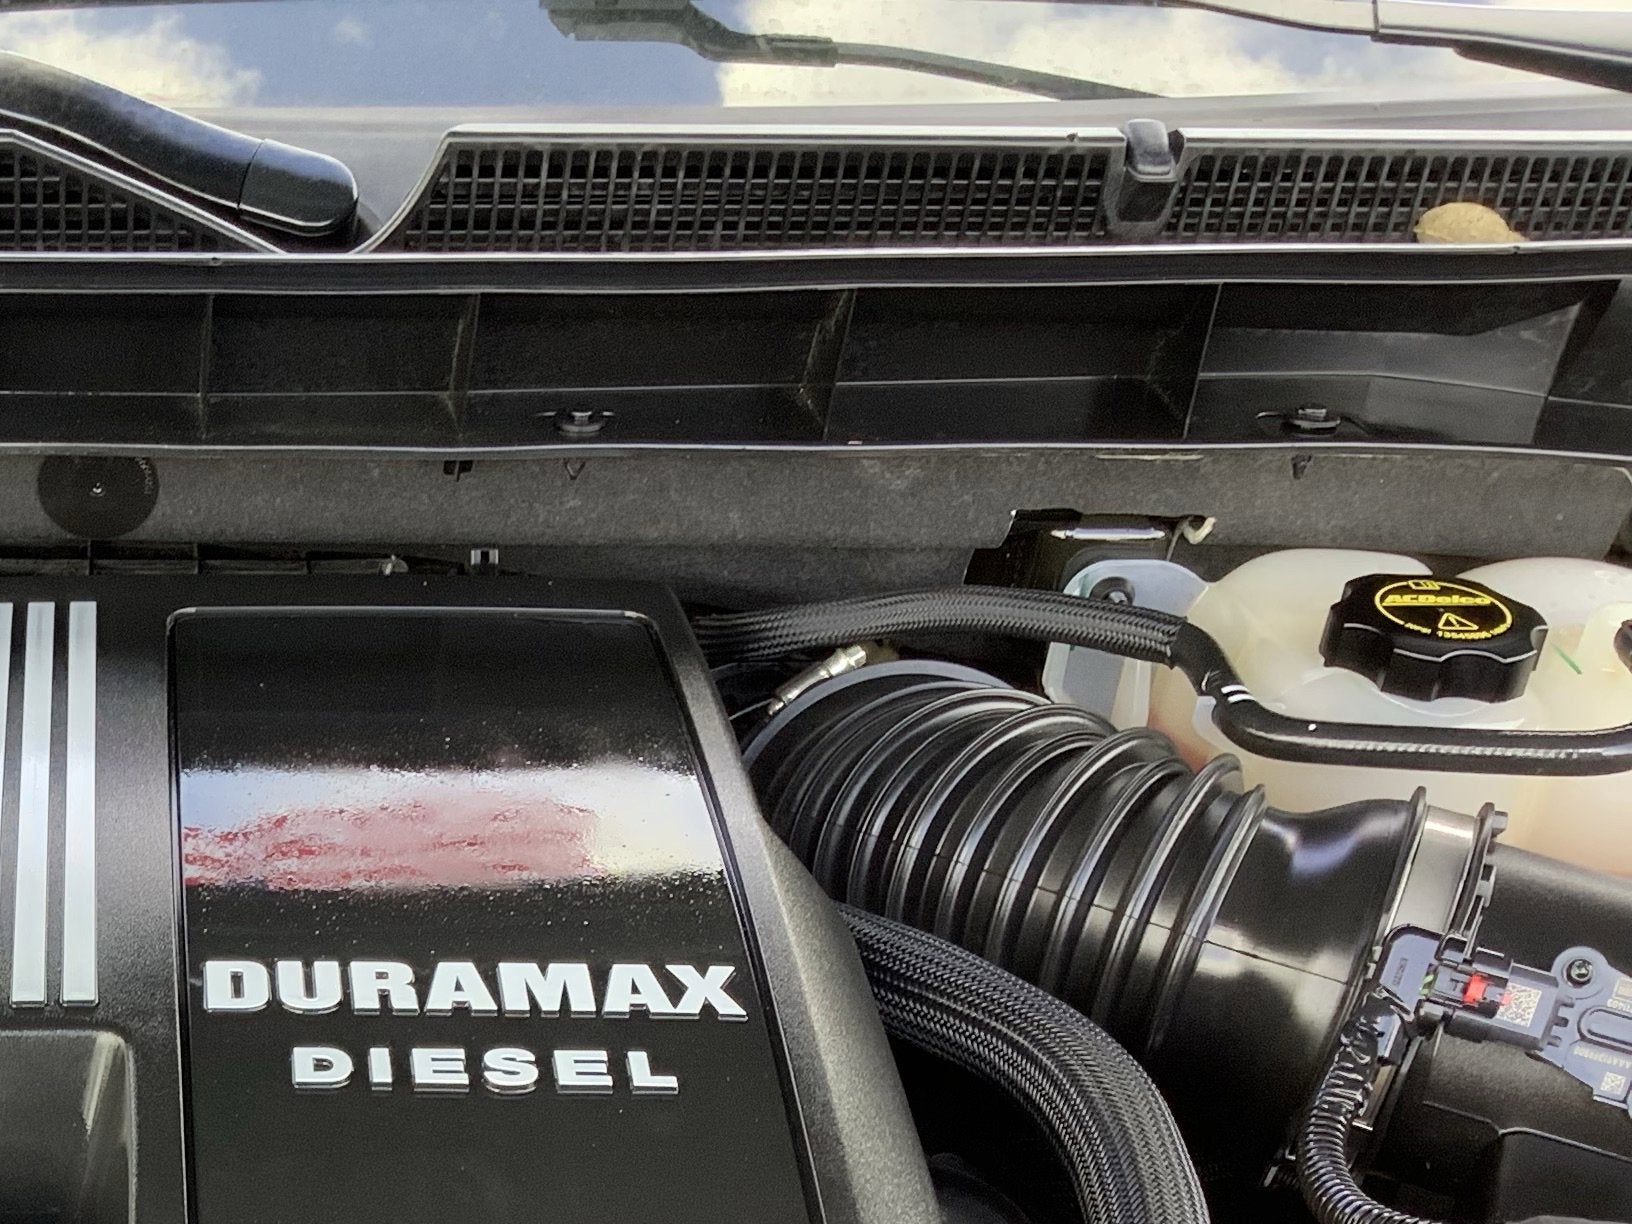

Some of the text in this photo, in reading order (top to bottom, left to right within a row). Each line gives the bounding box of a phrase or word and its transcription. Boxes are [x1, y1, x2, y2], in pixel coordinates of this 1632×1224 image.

[1383, 594, 1491, 605] ACDelco
[201, 959, 749, 1022] DURAMAX
[290, 1045, 679, 1095] DIESEL
